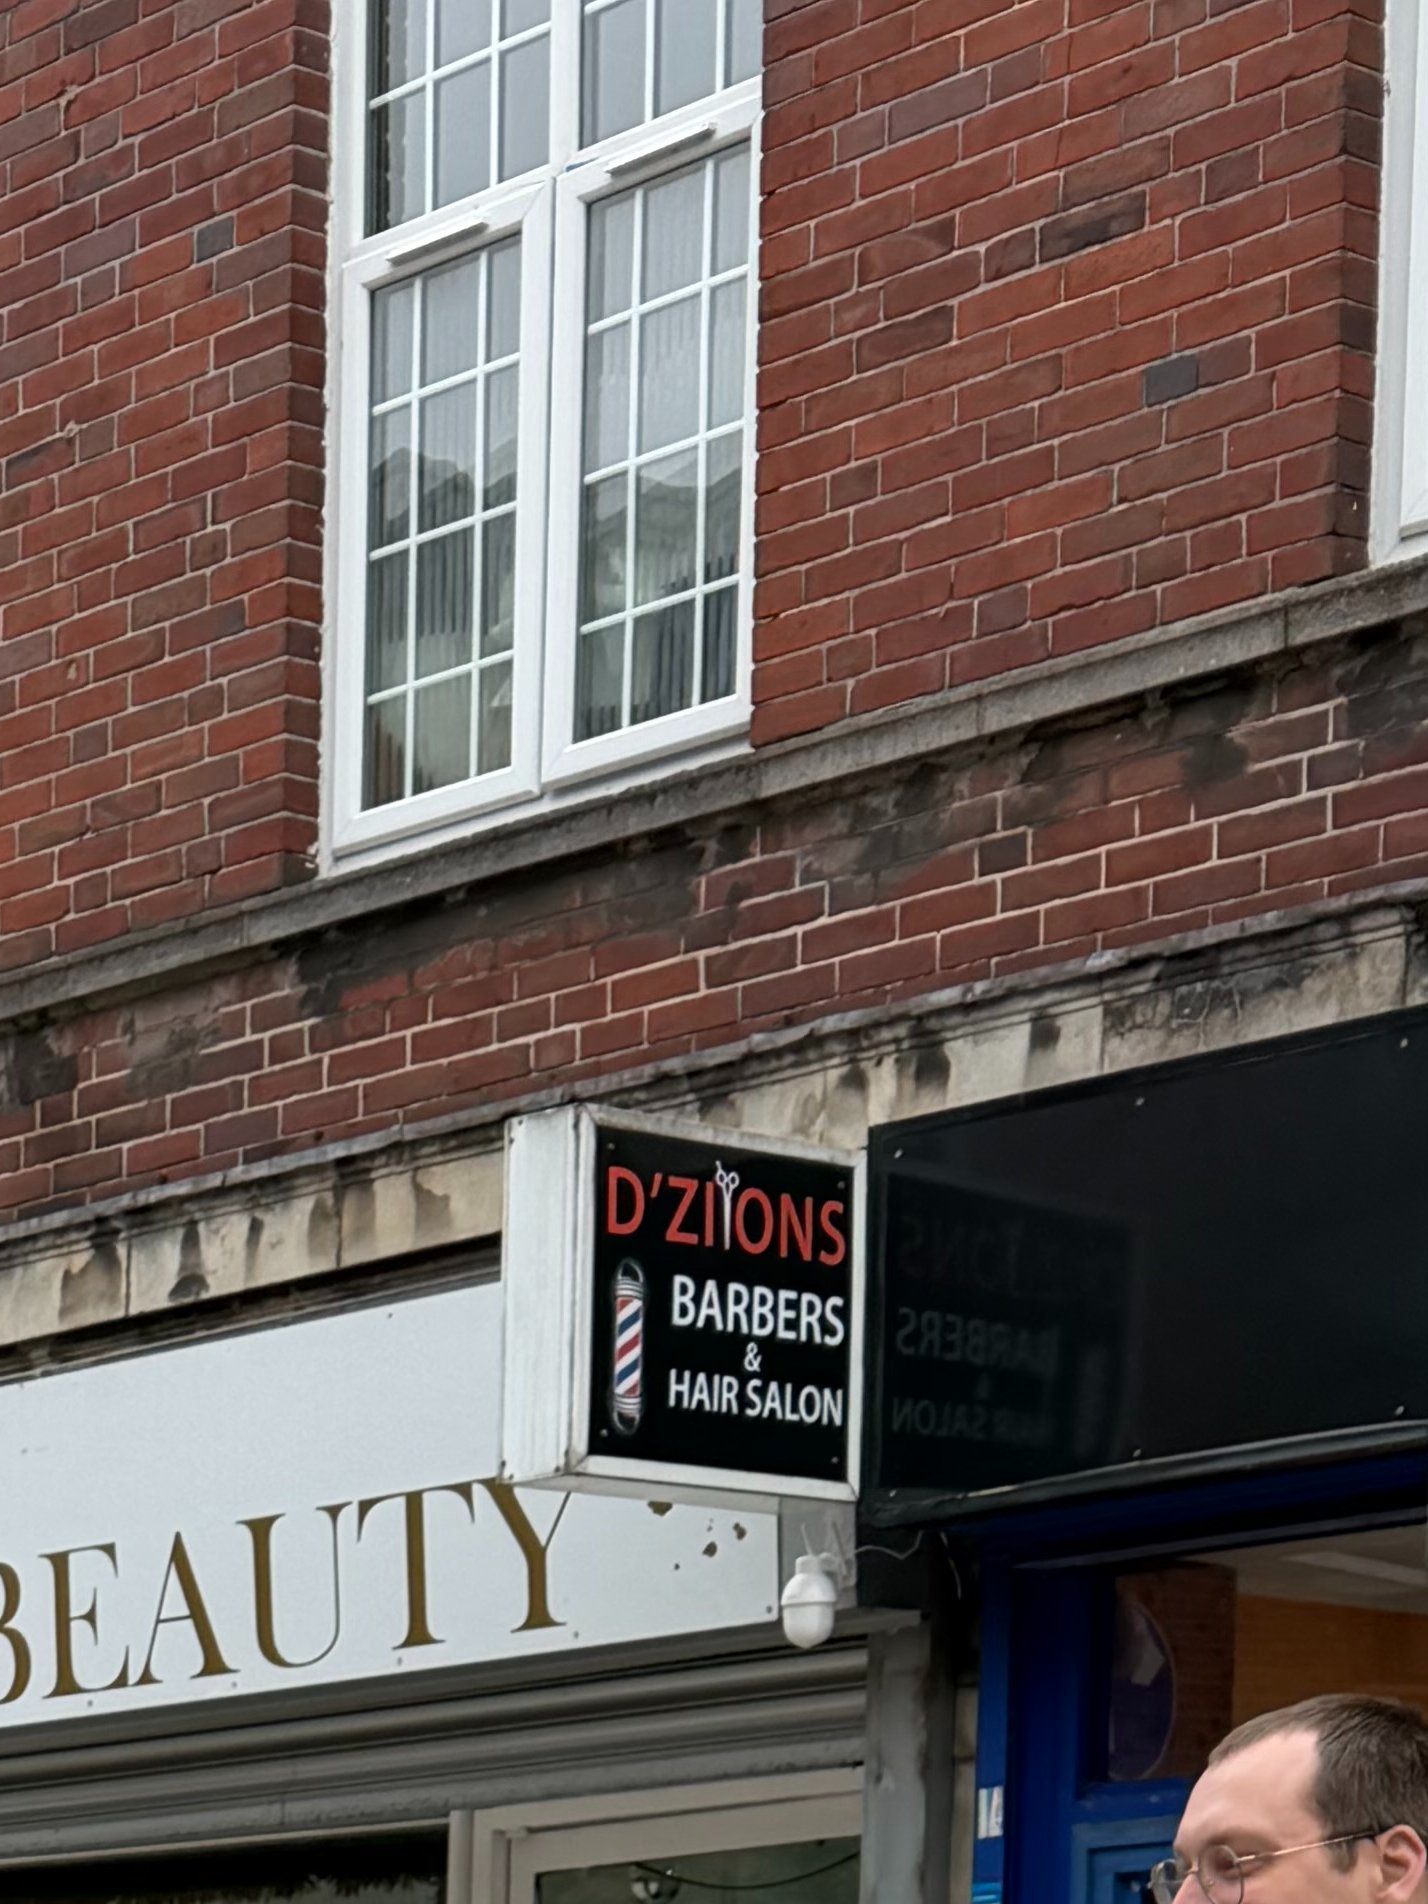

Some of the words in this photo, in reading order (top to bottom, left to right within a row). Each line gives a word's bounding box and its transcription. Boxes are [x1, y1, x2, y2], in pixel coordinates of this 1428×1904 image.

[671, 1274, 845, 1347] BARBERS
[743, 1341, 763, 1373] &
[668, 1368, 739, 1415] HAIR
[745, 1378, 843, 1427] SALON
